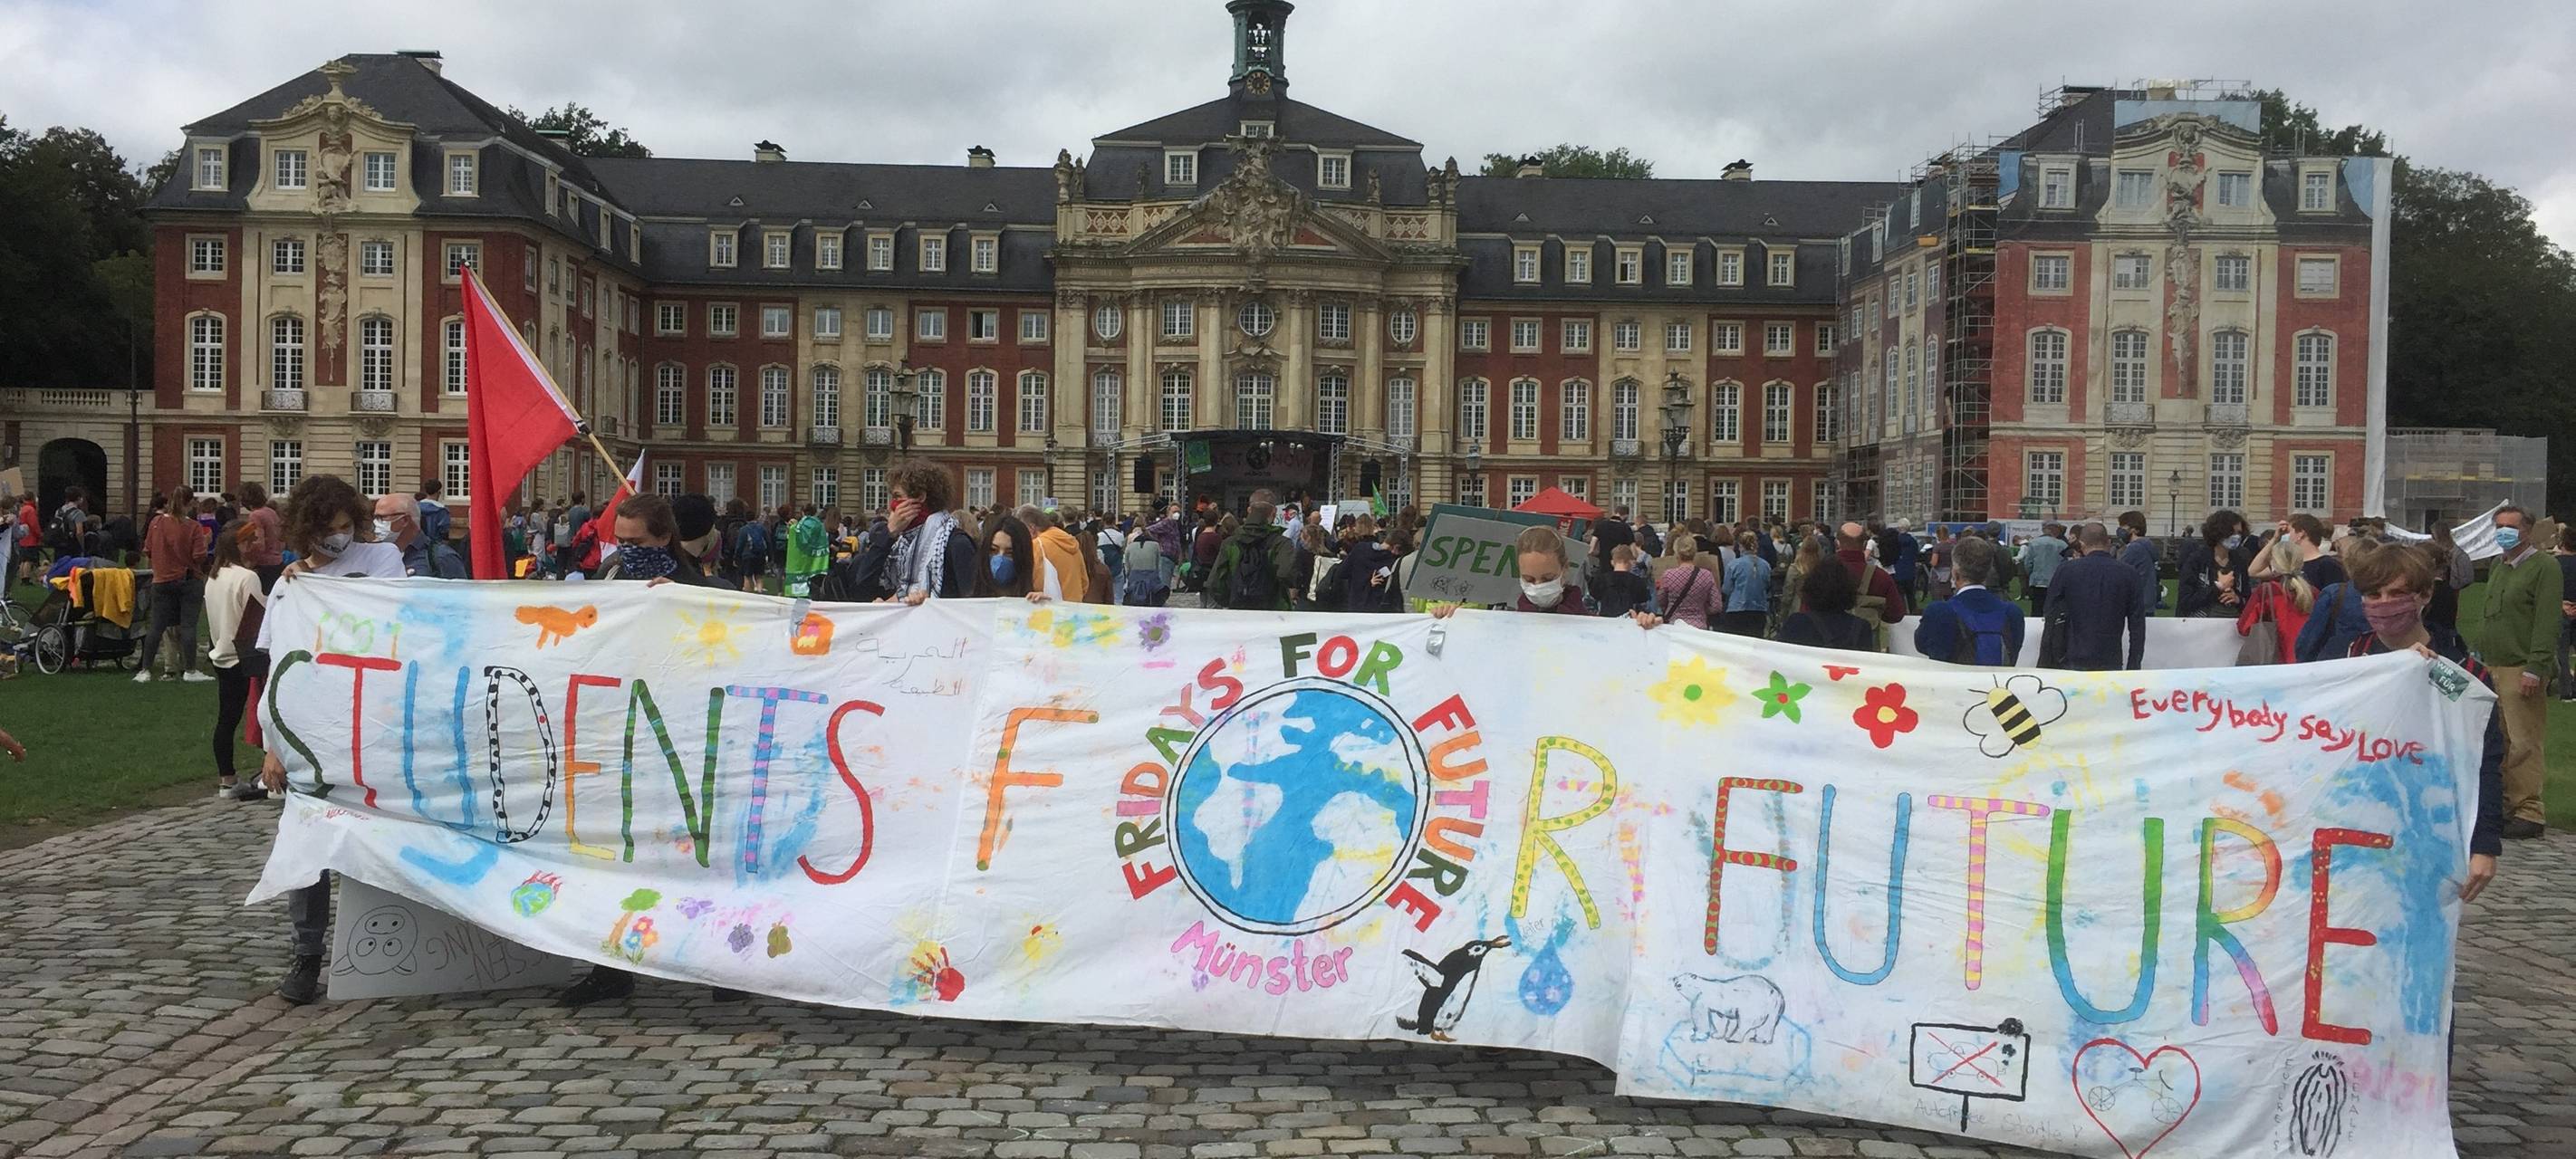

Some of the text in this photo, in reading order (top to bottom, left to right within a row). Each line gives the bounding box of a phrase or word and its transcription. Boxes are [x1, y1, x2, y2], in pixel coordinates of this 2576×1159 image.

[2437, 661, 2454, 676] WIR
[2439, 676, 2456, 691] FÜR
[1115, 632, 1490, 933] FRIDAYS FOR FUTURE
[268, 649, 885, 886] STUDENTS
[1705, 776, 2394, 1045] FUTURE
[1170, 920, 1353, 996] Münster
